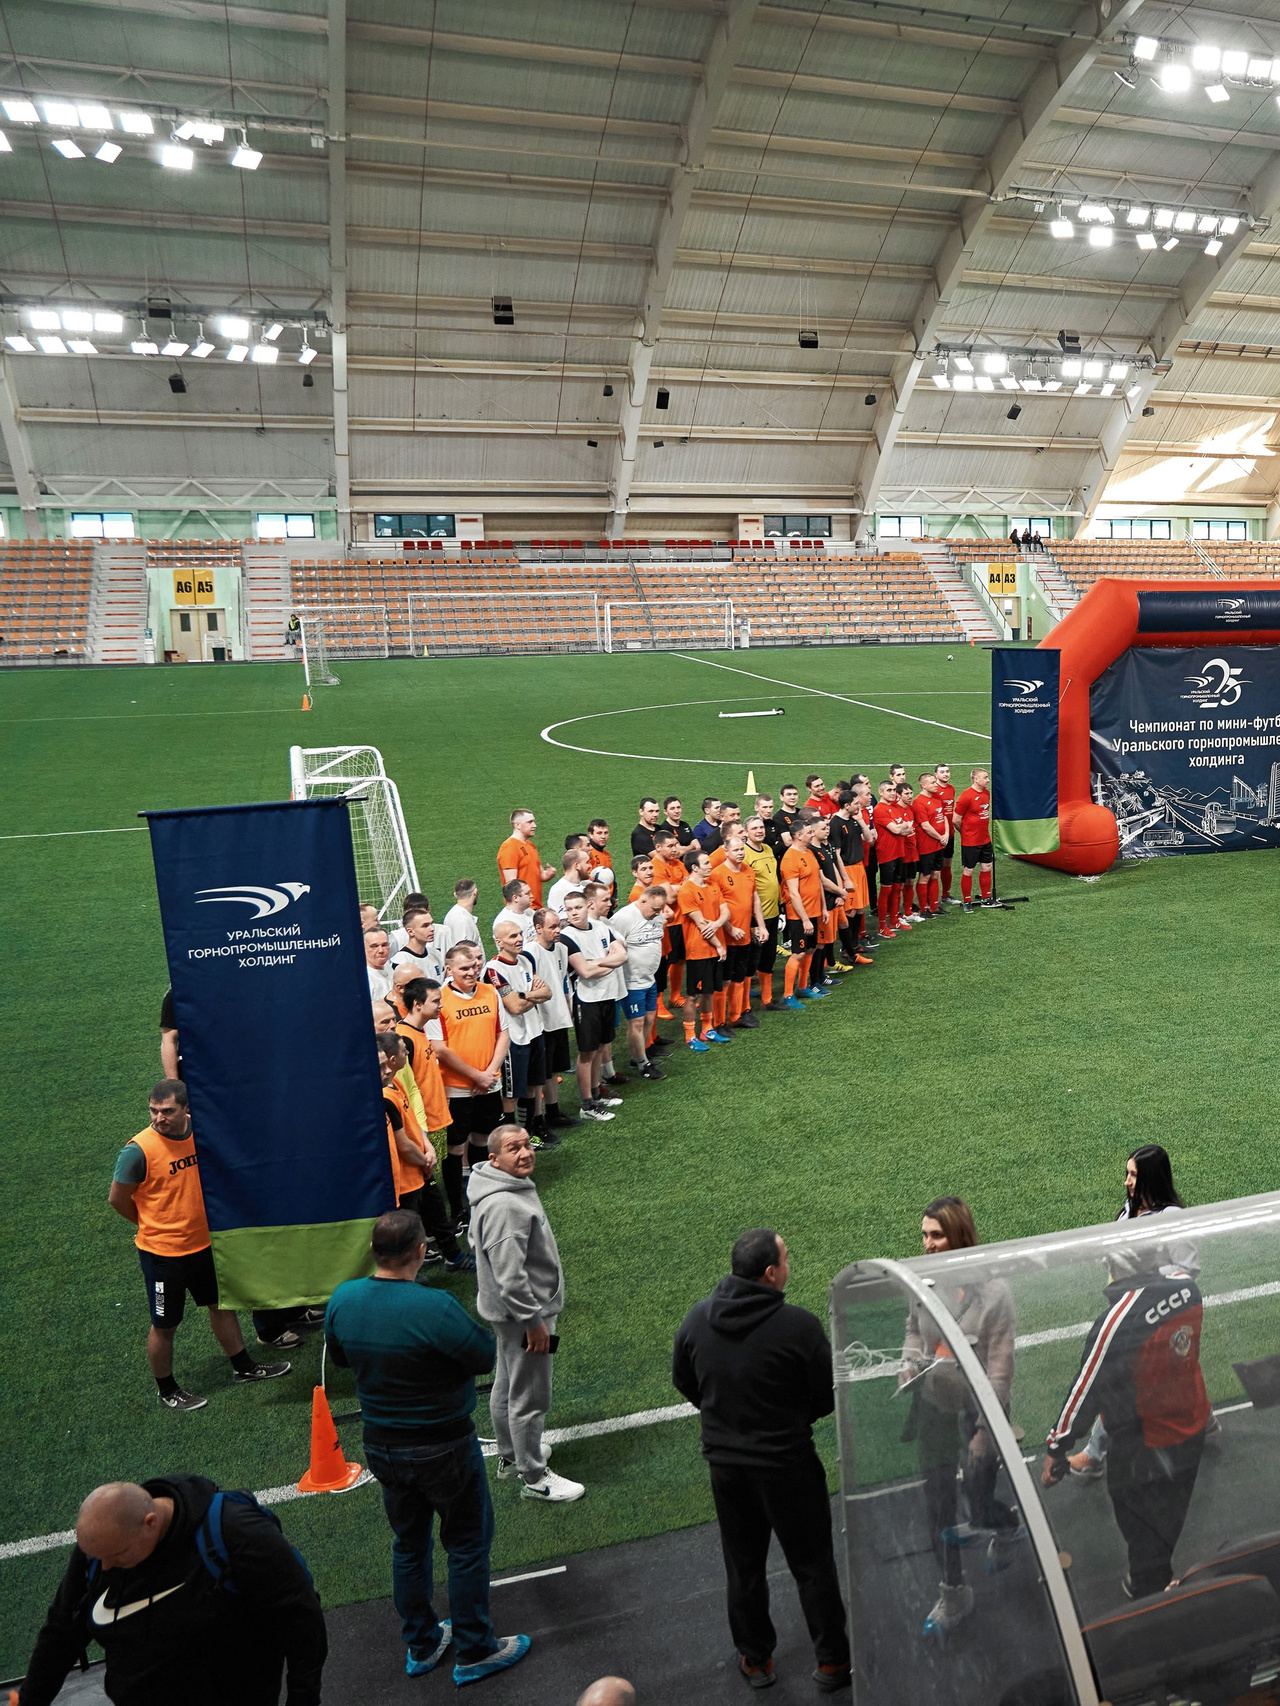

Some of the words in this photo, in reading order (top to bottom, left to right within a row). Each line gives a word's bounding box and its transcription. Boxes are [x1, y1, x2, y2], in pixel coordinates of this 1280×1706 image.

[1129, 719, 1196, 734] Чемпионат
[1199, 720, 1214, 731] по
[1112, 738, 1185, 756] Уральского
[1188, 754, 1245, 769] холдинга
[226, 923, 302, 942] УРАЛЬСКИЙ
[188, 934, 342, 960] ГОРНОПРОМЫШЛЕННЫЙ
[799, 938, 806, 949] 3
[238, 954, 297, 969] ХОЛДИНГ
[629, 1003, 640, 1014] 14
